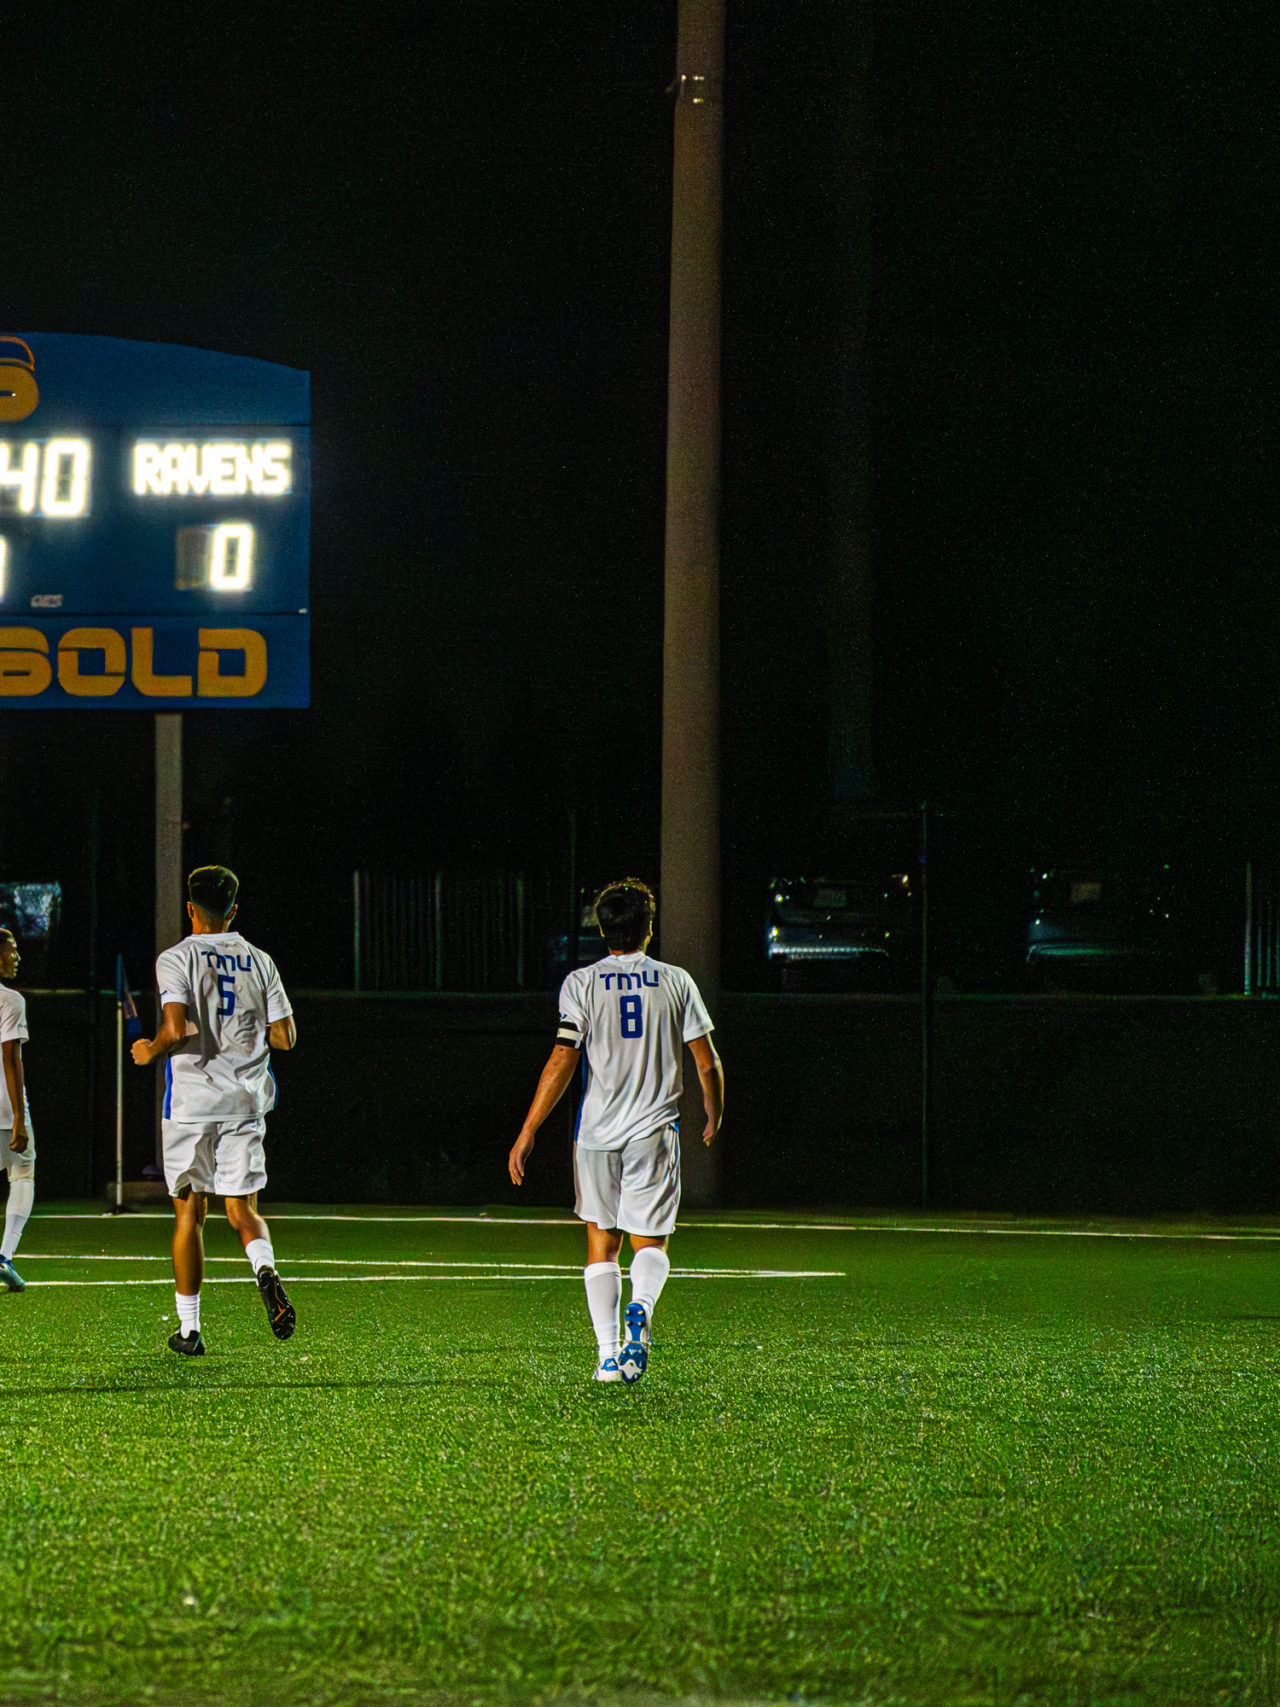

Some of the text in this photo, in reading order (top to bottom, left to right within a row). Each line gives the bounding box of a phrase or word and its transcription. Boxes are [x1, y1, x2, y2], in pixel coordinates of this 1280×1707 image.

[131, 440, 291, 497] RAVENS
[208, 521, 255, 592] 0
[201, 951, 251, 972] TMU
[599, 970, 659, 990] TMU
[216, 974, 236, 1017] 5
[619, 994, 643, 1039] 8
